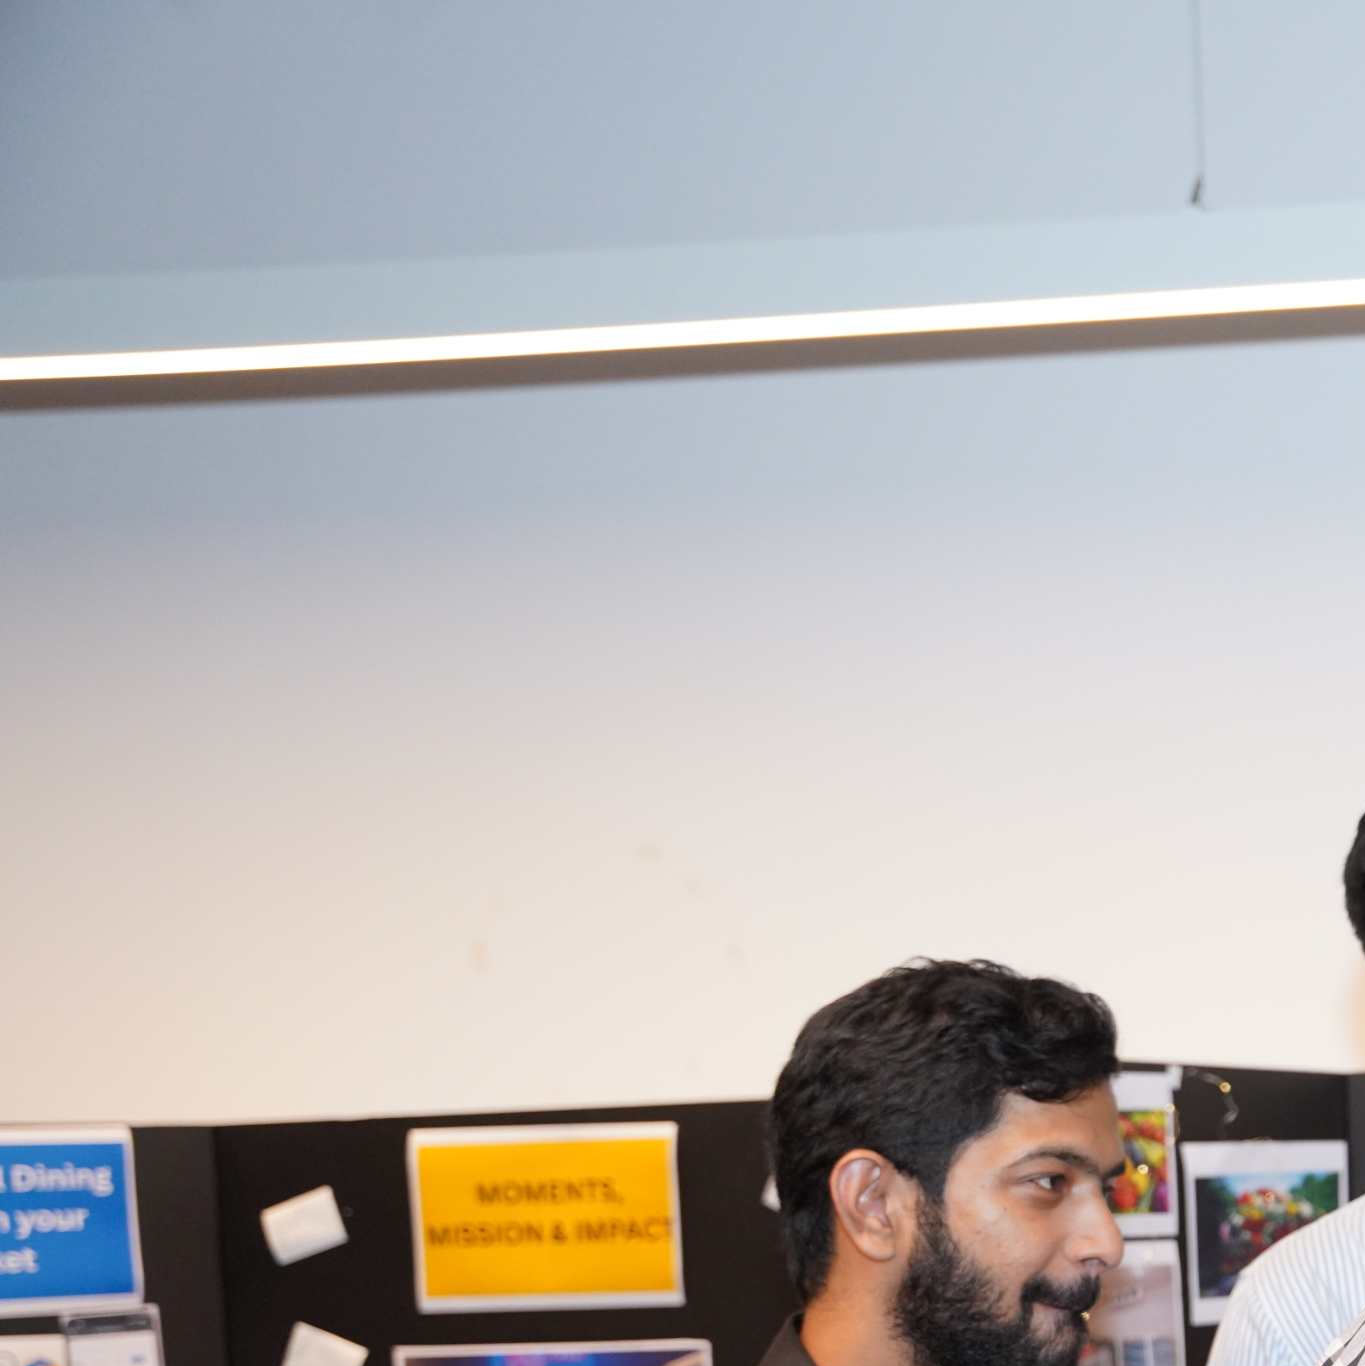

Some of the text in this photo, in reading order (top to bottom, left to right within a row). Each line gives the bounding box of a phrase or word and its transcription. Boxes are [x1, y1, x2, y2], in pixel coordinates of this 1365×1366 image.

[11, 1162, 114, 1197] Dining
[476, 1177, 624, 1206] MOMENTS,
[14, 1209, 90, 1240] your
[427, 1215, 672, 1247] MISSION & IMPACT
